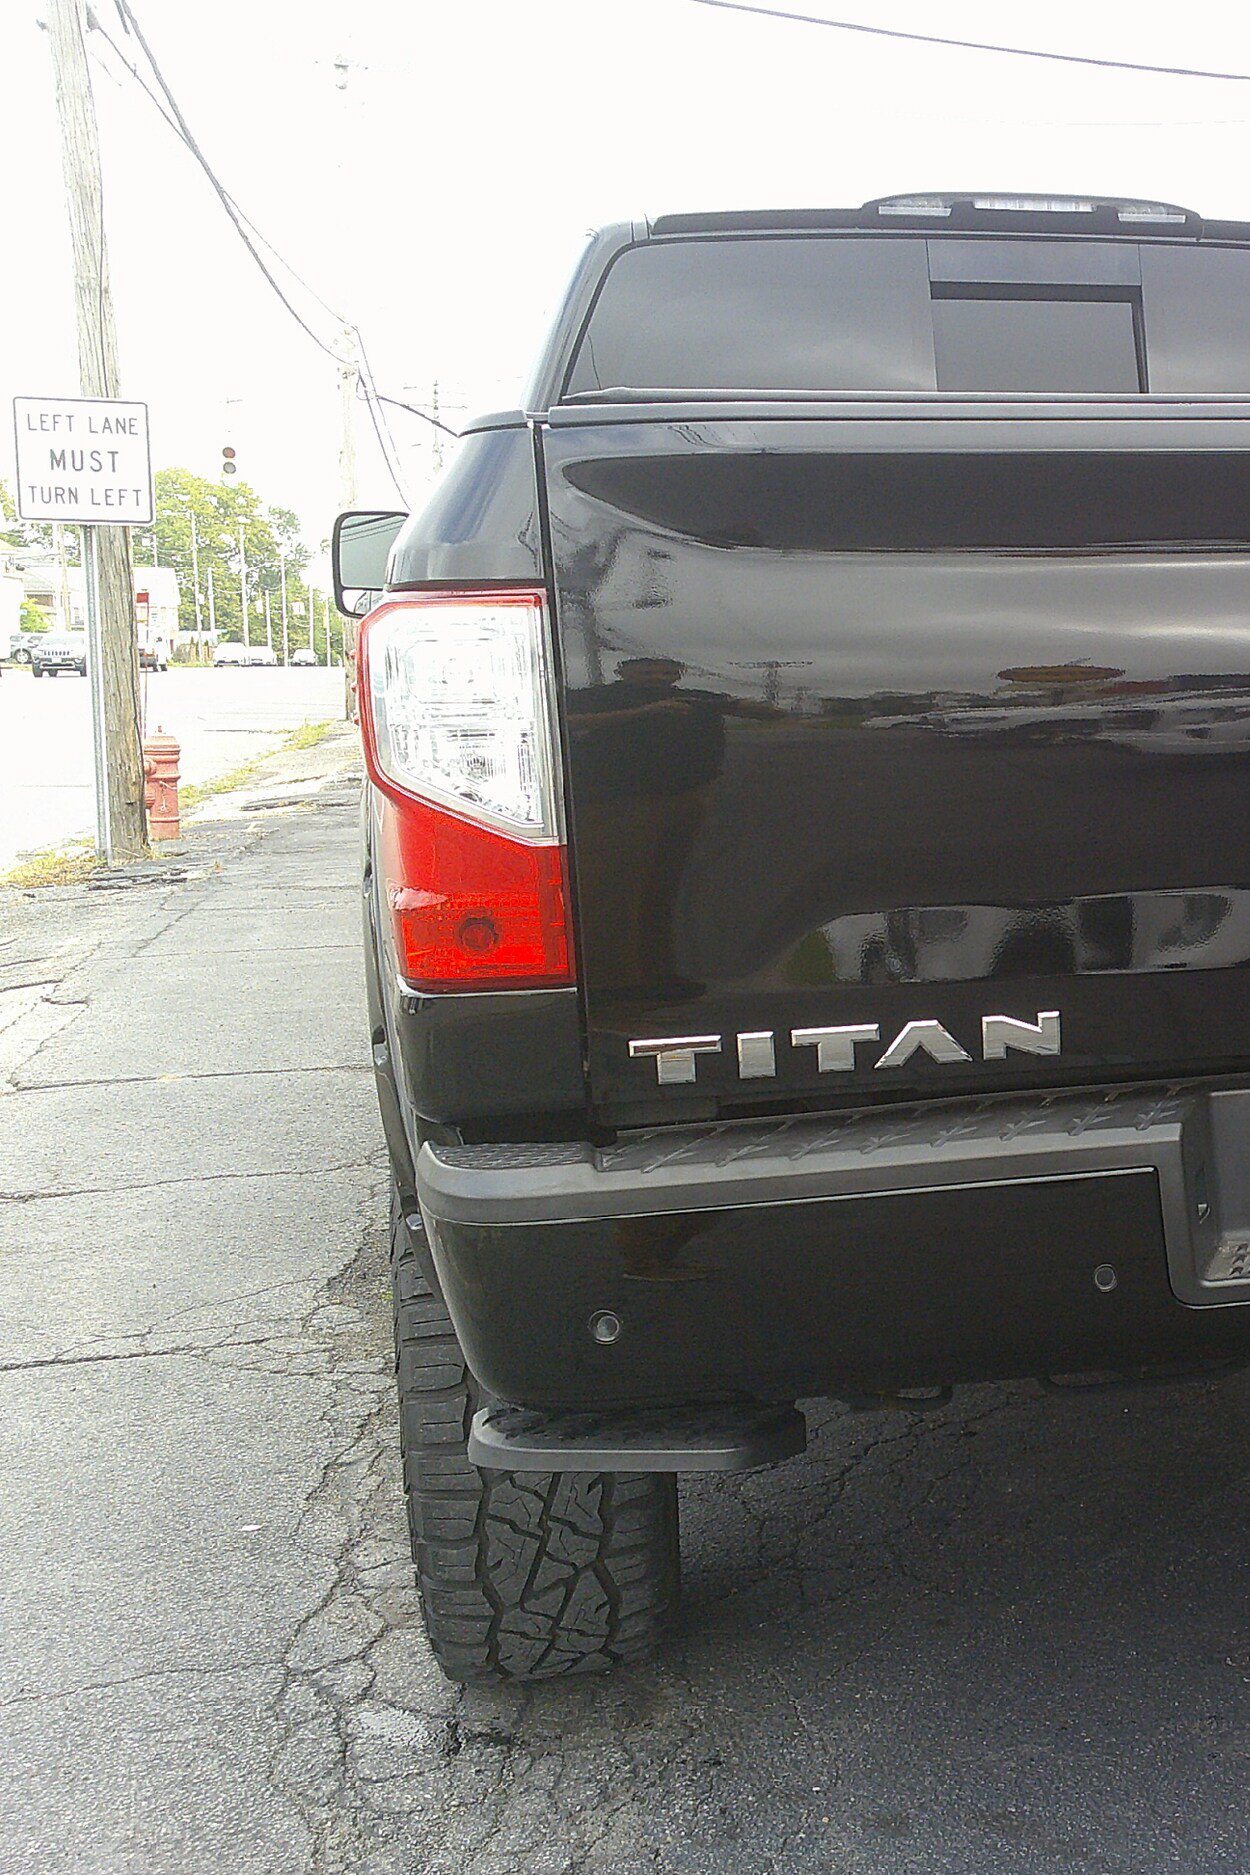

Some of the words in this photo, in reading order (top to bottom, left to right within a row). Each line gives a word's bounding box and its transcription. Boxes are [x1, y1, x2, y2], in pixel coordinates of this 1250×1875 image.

[27, 413, 75, 432] LEFT
[88, 416, 138, 435] LANE
[50, 449, 119, 472] MUST
[28, 486, 79, 504] TURN
[91, 488, 141, 507] LEFT
[628, 1010, 1061, 1085] TITAN
